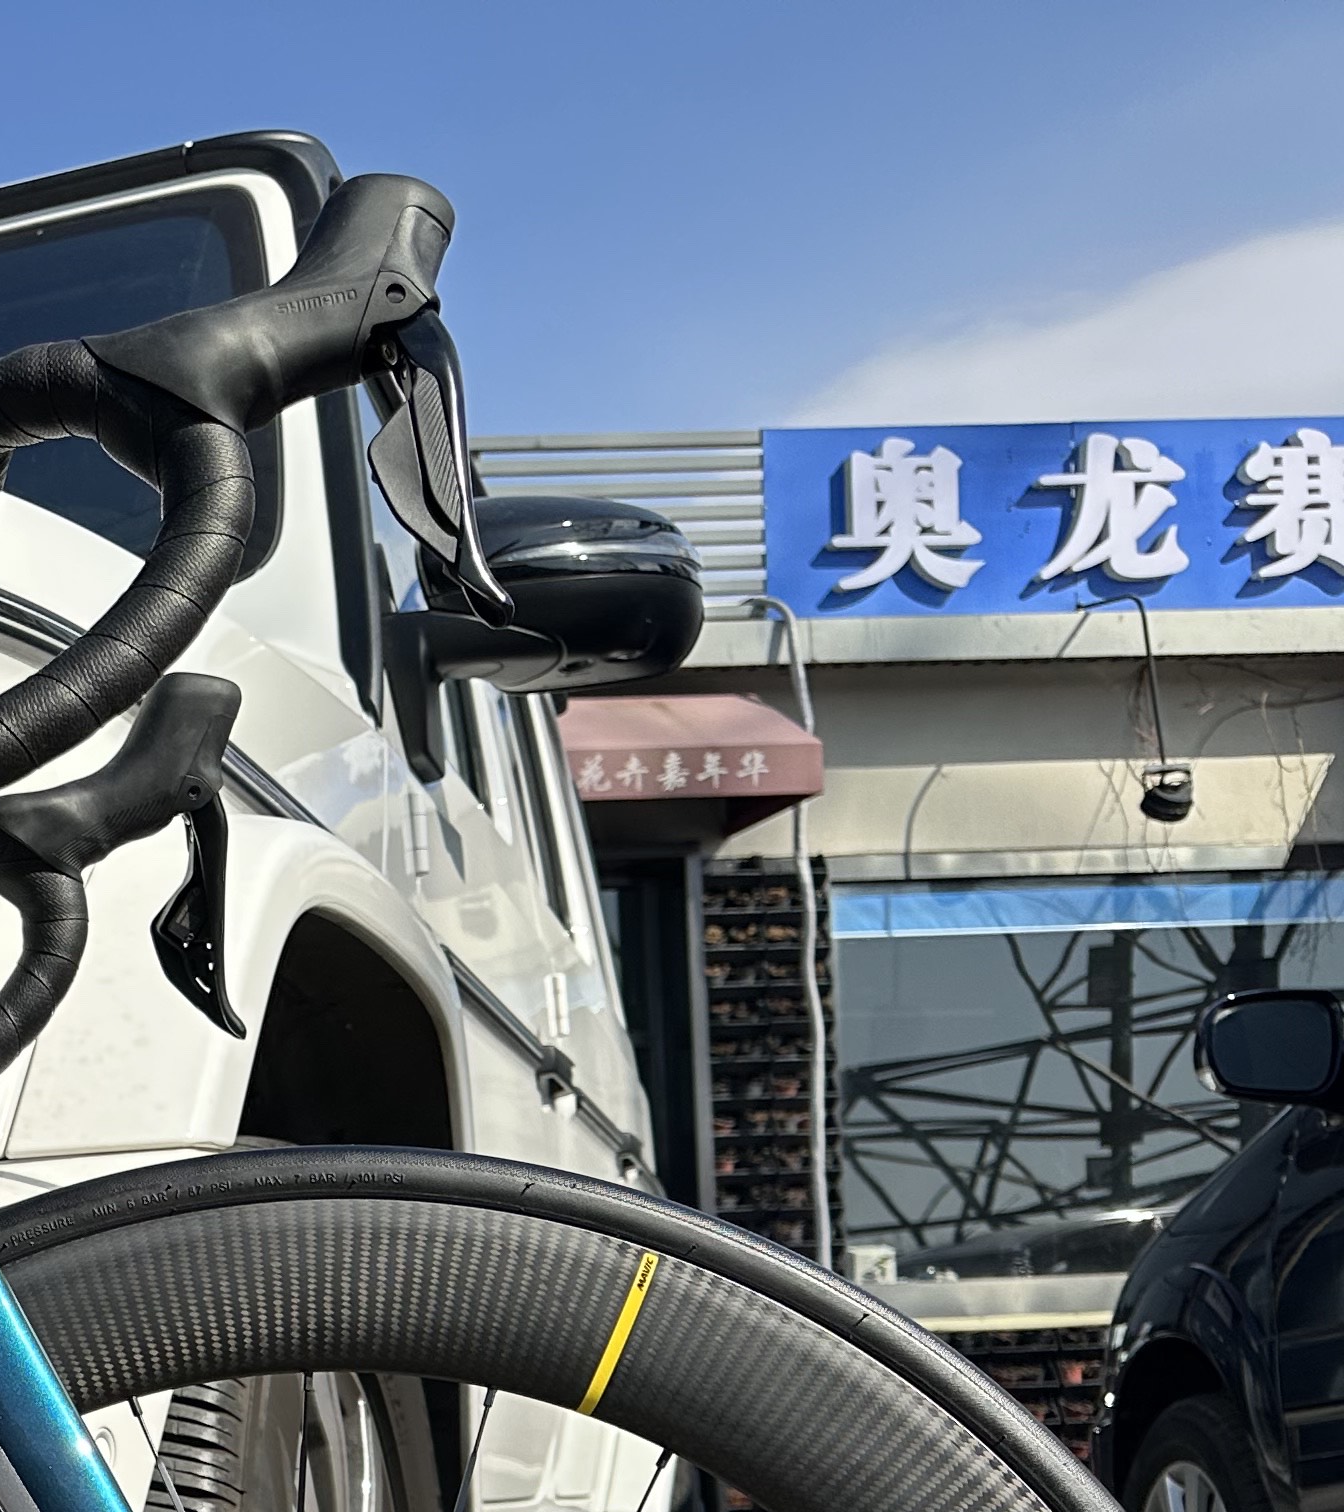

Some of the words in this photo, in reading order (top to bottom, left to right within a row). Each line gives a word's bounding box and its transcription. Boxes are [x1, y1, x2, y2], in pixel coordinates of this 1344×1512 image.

[275, 289, 357, 314] SHIMANO
[832, 427, 1344, 593] 奥龙赛
[576, 750, 770, 793] 花卉嘉年华
[309, 1172, 337, 1184] BAR
[384, 1173, 406, 1185] PSI
[637, 1257, 654, 1291] MAVIC
